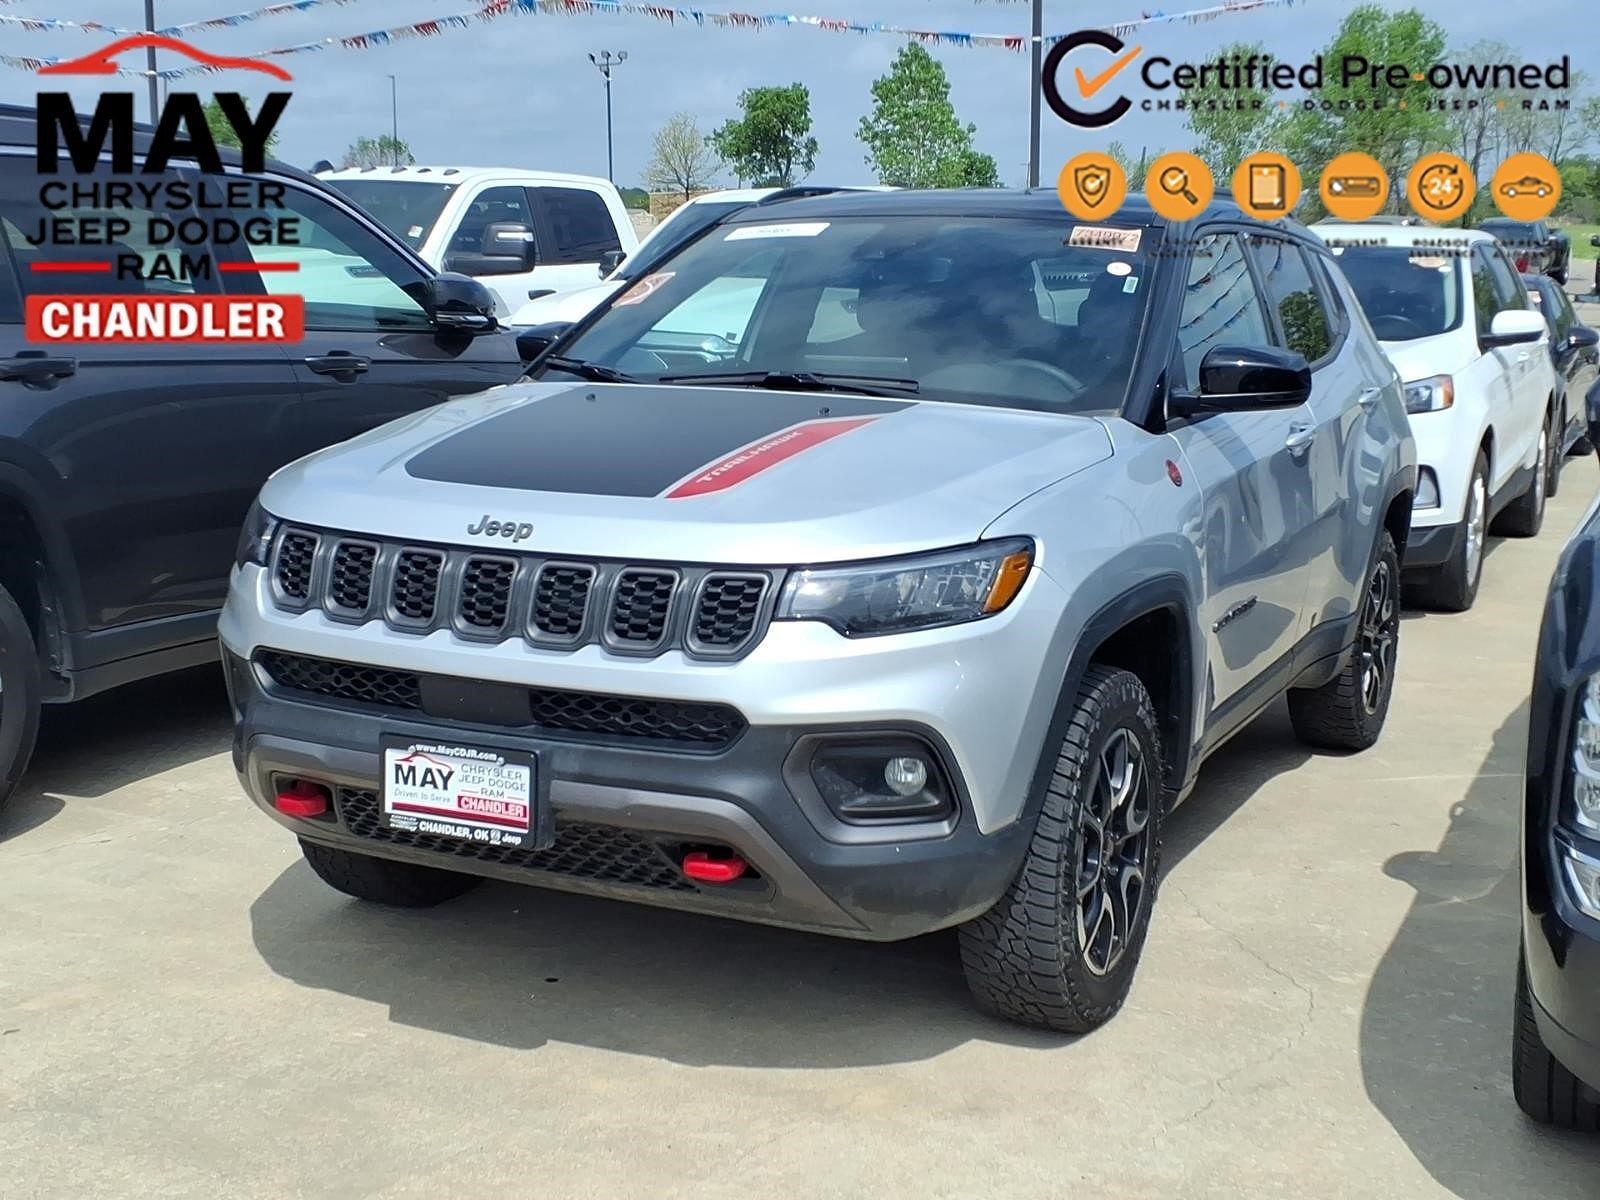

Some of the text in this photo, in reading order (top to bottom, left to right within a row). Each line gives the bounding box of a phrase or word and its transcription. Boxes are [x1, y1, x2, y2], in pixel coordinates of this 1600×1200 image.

[467, 514, 534, 543] Jeep
[394, 763, 455, 791] MAY
[461, 763, 522, 780] CHRYSLER
[459, 774, 526, 792] JEEP DODGE
[480, 787, 505, 799] RAM
[460, 797, 524, 817] CHANDLER
[474, 829, 489, 841] OK
[502, 833, 521, 845] Jeep
